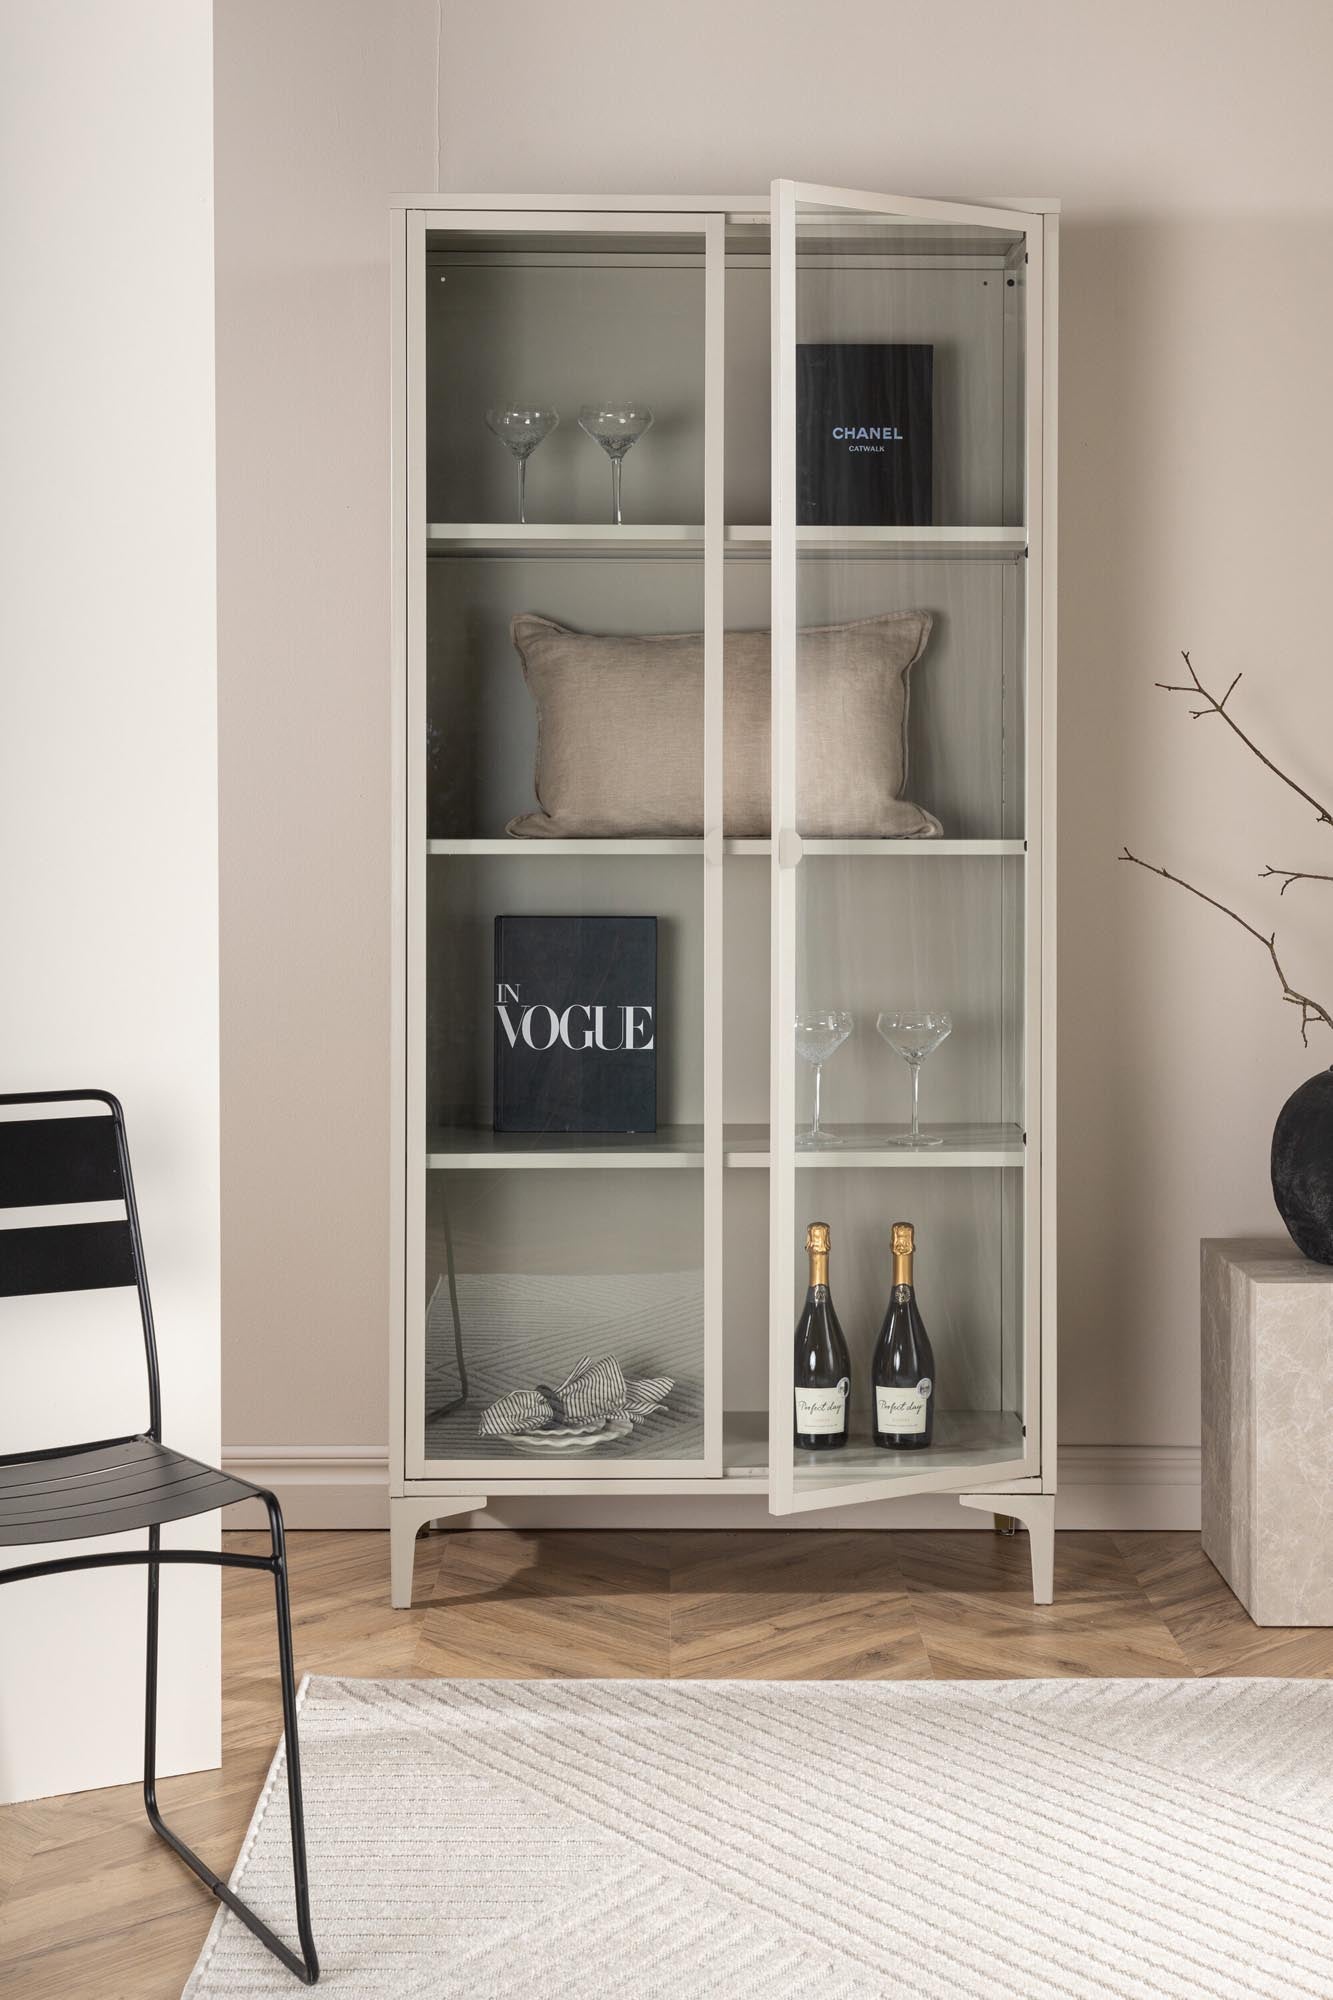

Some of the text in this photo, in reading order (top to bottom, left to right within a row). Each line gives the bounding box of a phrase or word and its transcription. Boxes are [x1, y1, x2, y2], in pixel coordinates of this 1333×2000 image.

[832, 427, 903, 440] CHANEL
[496, 983, 521, 1003] IN
[494, 1004, 654, 1051] VOGUE
[799, 1400, 827, 1415] Perfect
[879, 1400, 906, 1414] Perfect
